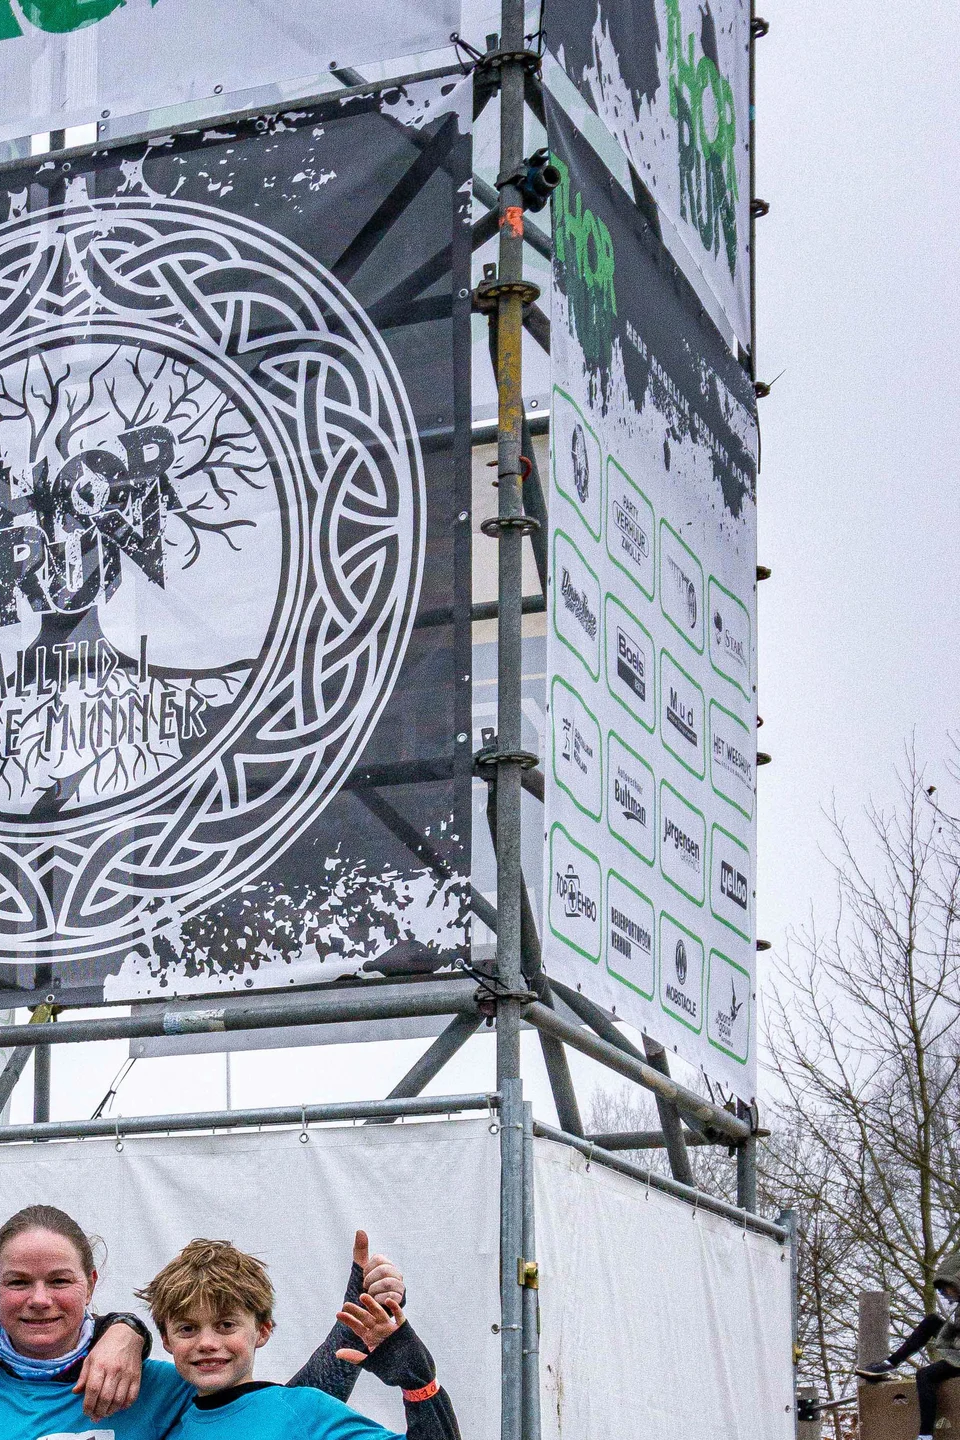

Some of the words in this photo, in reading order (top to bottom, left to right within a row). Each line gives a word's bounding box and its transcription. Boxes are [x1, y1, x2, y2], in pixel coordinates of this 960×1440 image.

[616, 505, 646, 554] VERHUUR
[137, 634, 149, 683] I
[618, 632, 644, 678] Boels
[44, 687, 208, 754] MINNER
[614, 778, 646, 825] Bultman
[577, 890, 597, 922] EHBO
